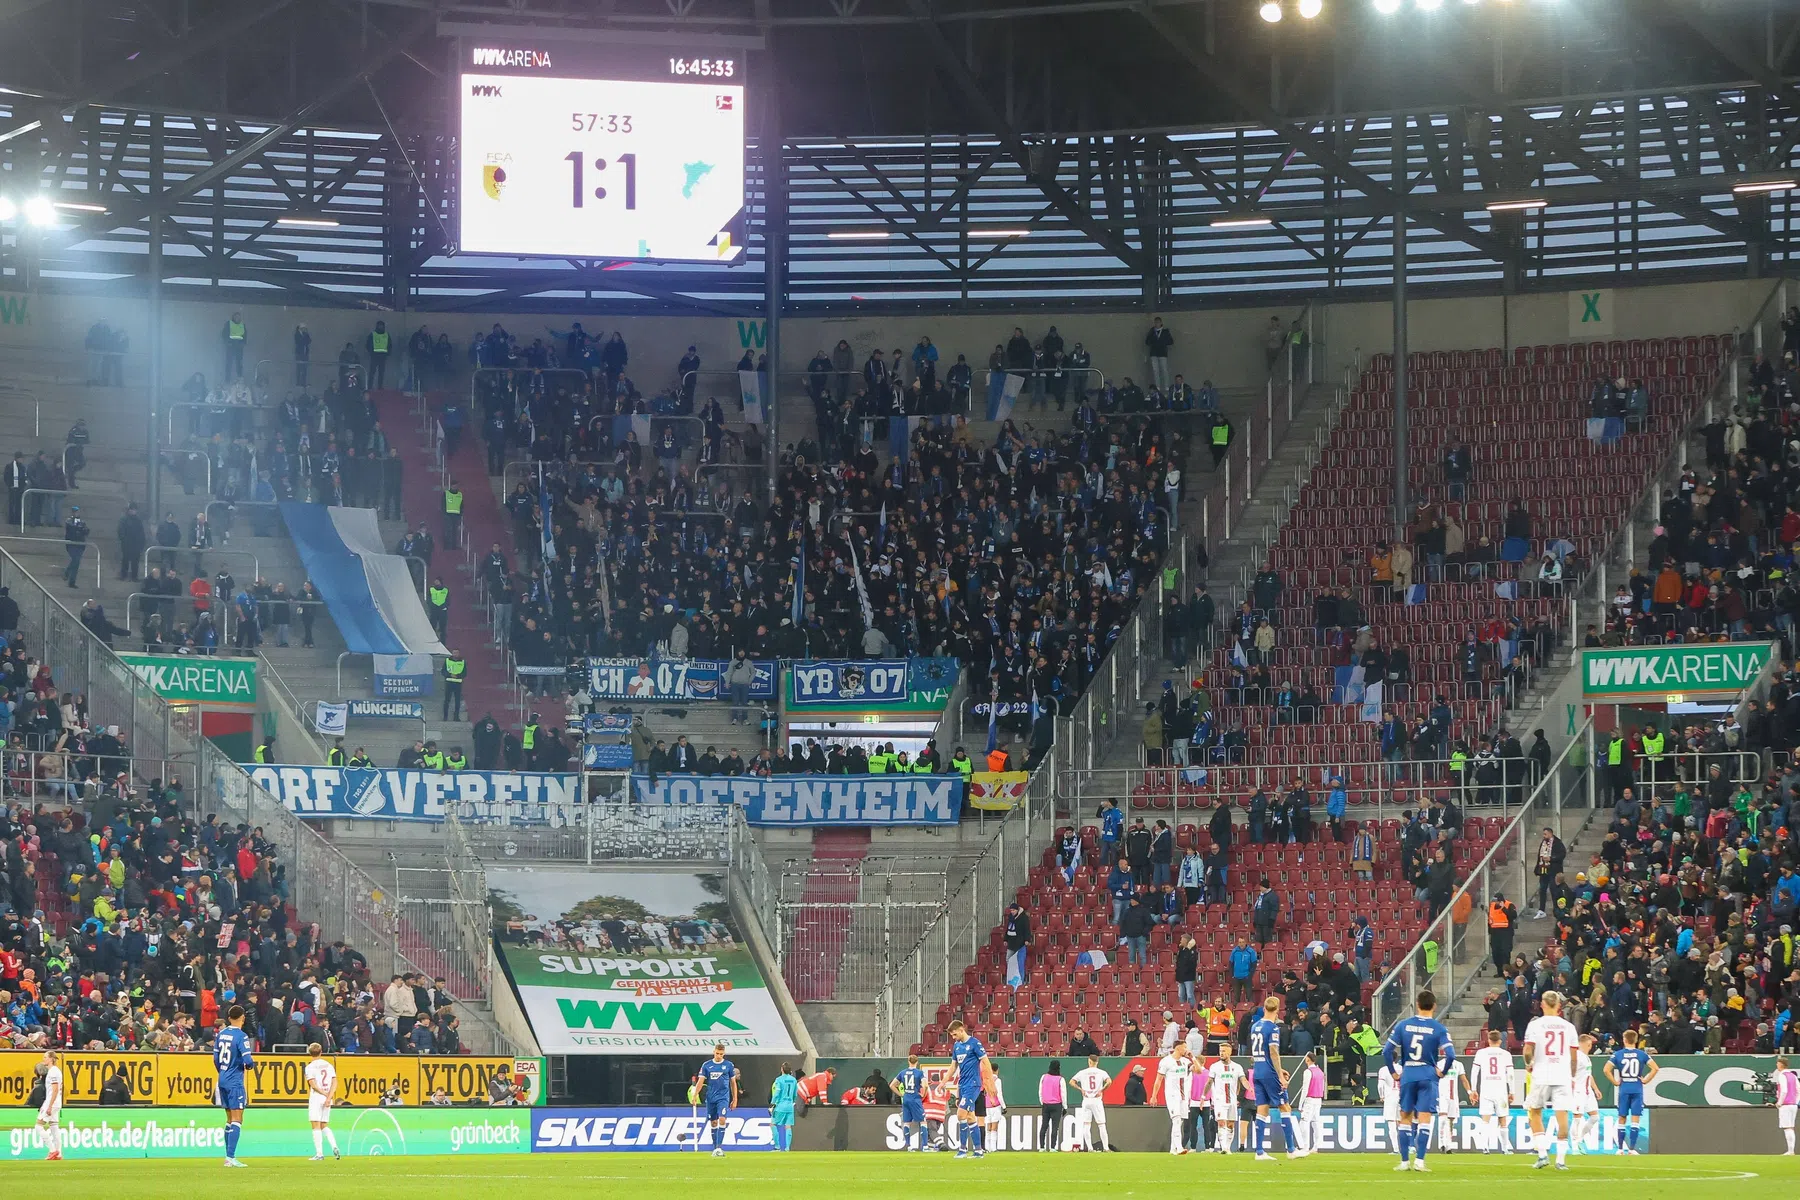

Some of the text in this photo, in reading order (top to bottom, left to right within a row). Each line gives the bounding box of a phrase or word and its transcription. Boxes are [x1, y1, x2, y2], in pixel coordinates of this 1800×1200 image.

[669, 58, 734, 77] 16:45:33
[472, 85, 503, 98] WWK
[572, 113, 633, 133] 57:33
[564, 151, 636, 210] 1:1
[0, 296, 28, 325] W
[1582, 293, 1602, 323] X
[737, 321, 767, 349] W
[689, 662, 715, 670] UNITED
[591, 663, 690, 695] CH 07
[798, 669, 834, 695] YB
[871, 668, 904, 694] 07
[353, 701, 412, 716] MÜNCHEN
[1013, 702, 1028, 714] 22
[1566, 704, 1577, 735] X
[386, 771, 579, 828] VEREIN
[637, 777, 953, 820] HOFFENHEIM
[538, 955, 729, 977] SUPPORT.
[661, 983, 726, 996] SICHER!
[556, 999, 751, 1032] WWK
[218, 1041, 232, 1065] 25
[572, 1037, 759, 1047] VERSICHERUNGEN
[1250, 1032, 1266, 1056] 22
[1408, 1034, 1424, 1061] 5
[1544, 1030, 1565, 1056] 21
[516, 1062, 537, 1073] FCA
[1489, 1056, 1498, 1075] 8
[1620, 1058, 1640, 1078] 20
[321, 1069, 329, 1087] 2
[343, 1073, 410, 1099] ytongde
[903, 1074, 916, 1090] 14
[1088, 1075, 1097, 1090] 6
[10, 1119, 225, 1156] grunbeck.de/karriere
[450, 1119, 520, 1152] grünbeck
